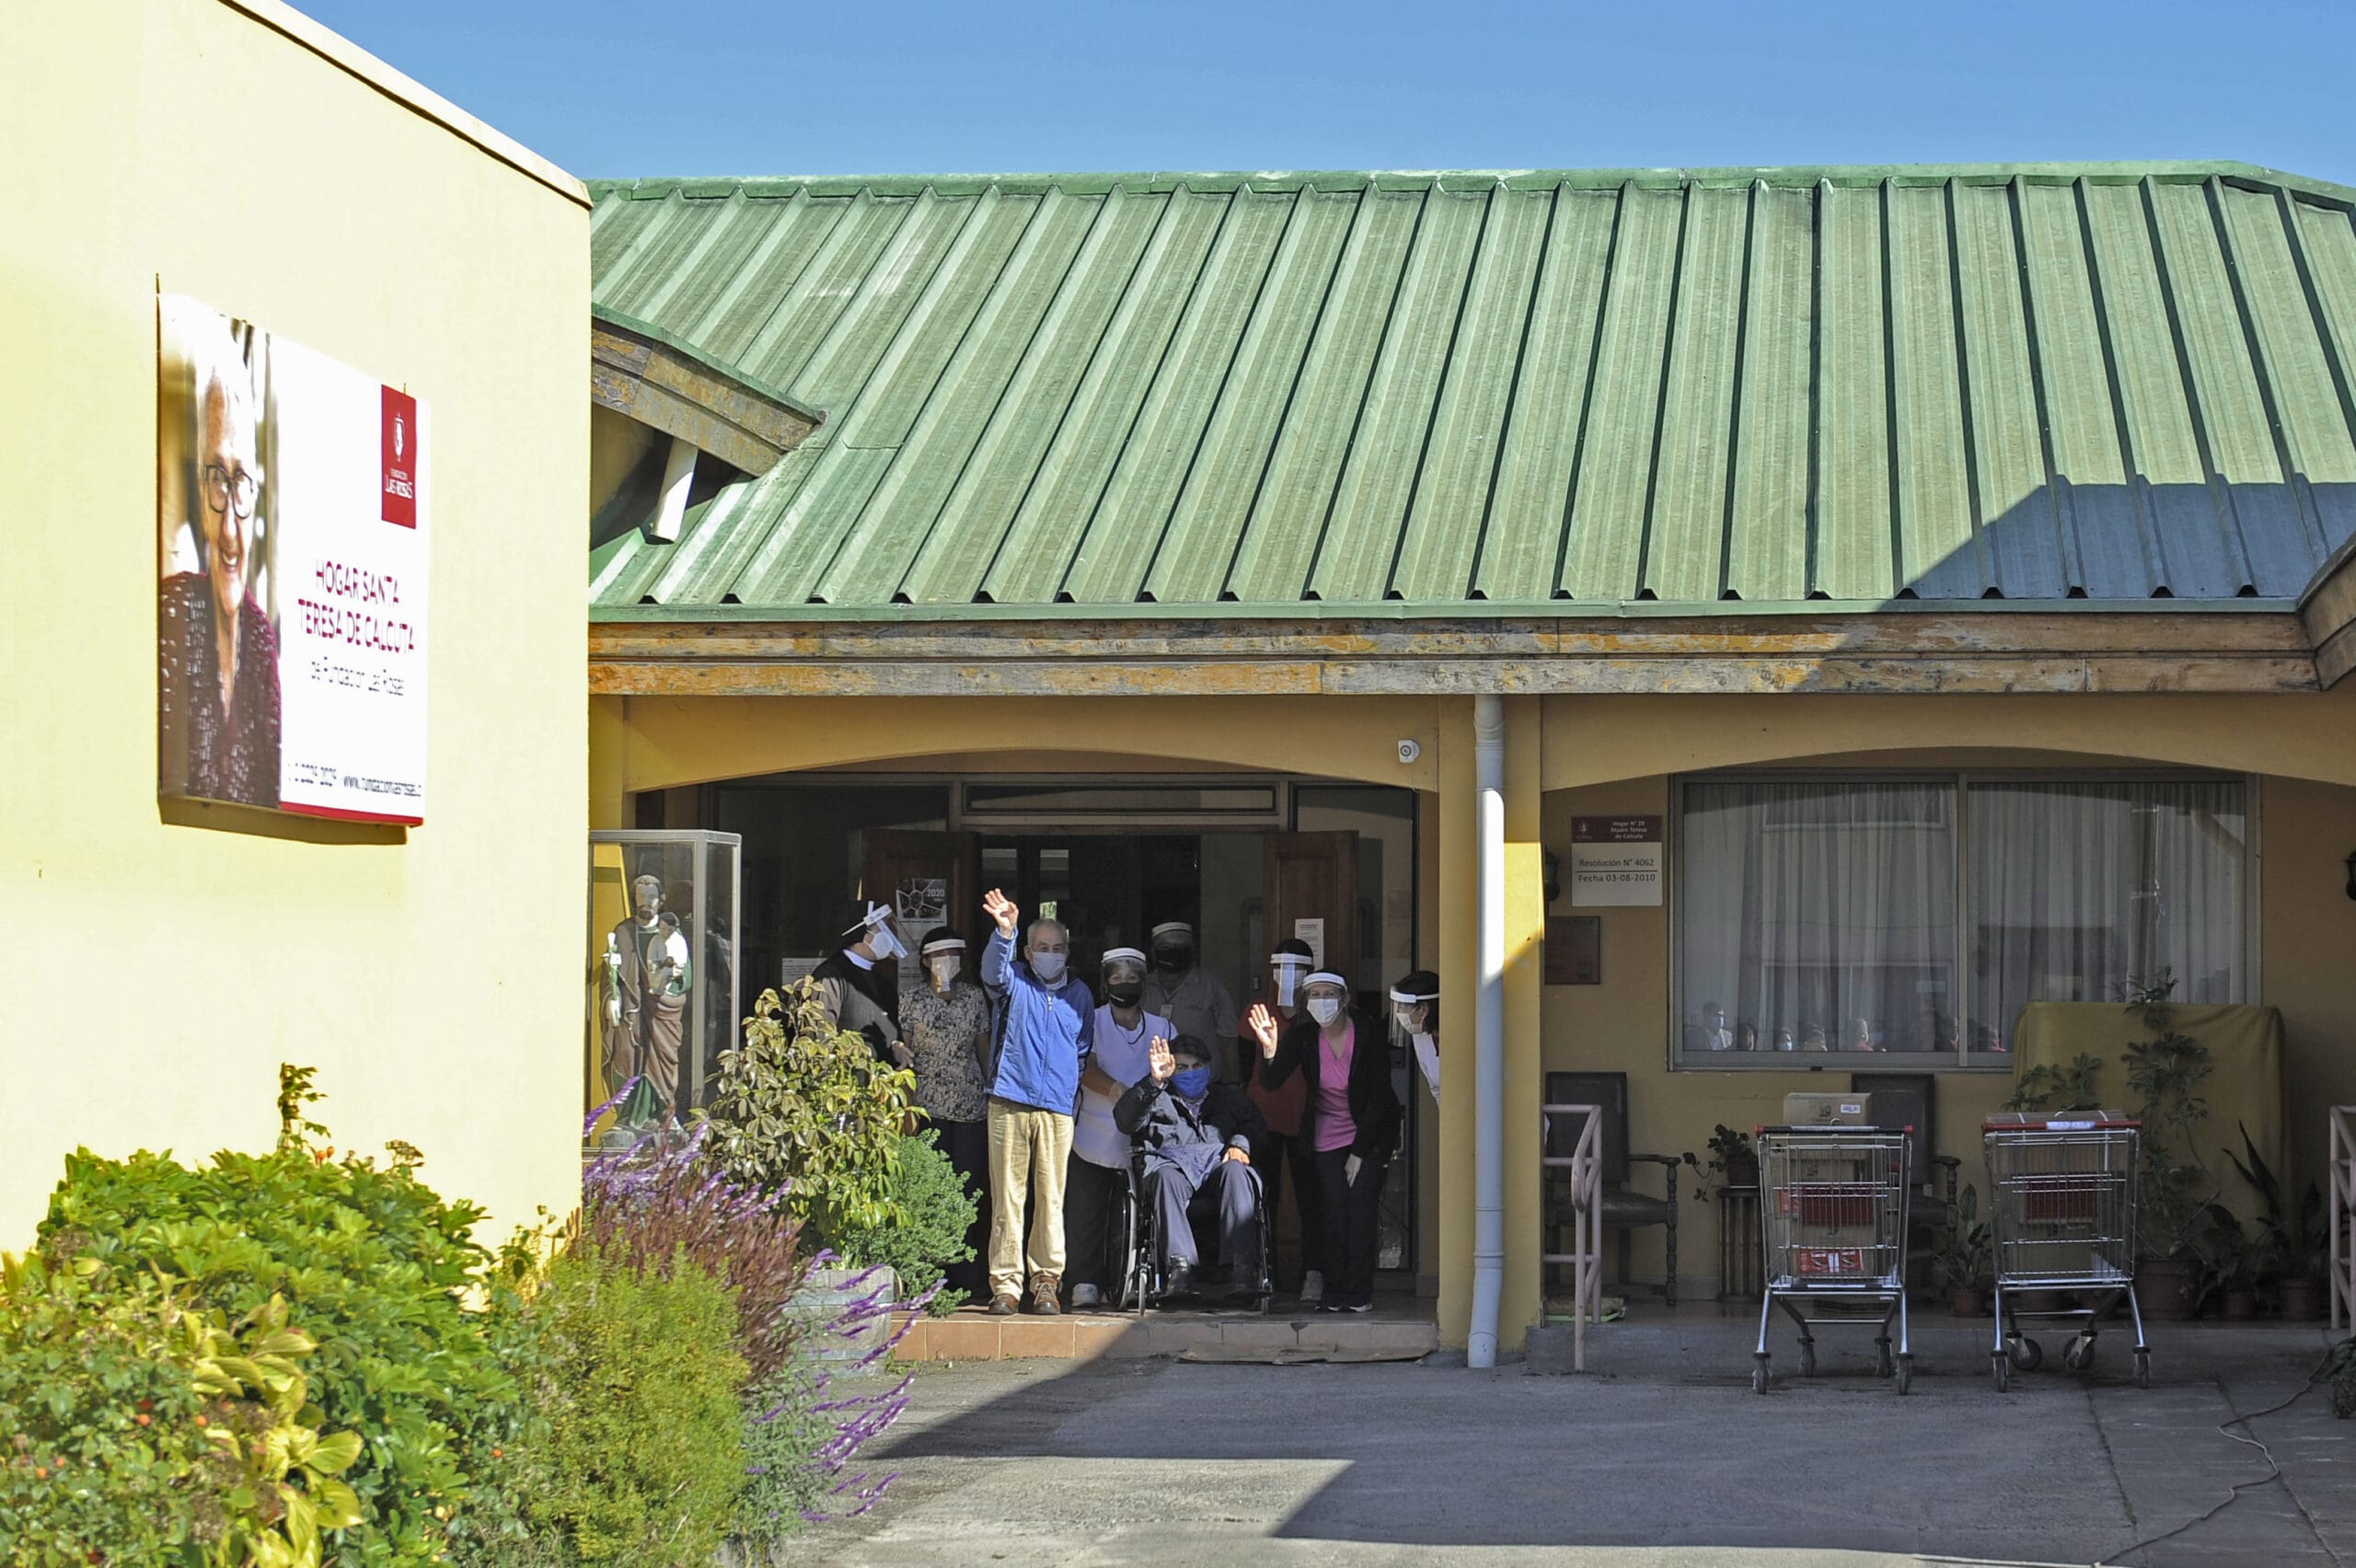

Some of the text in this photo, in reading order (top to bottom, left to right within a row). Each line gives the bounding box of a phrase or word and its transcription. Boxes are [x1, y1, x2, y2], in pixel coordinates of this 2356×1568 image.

[316, 558, 399, 608] HOGAR SANTA
[298, 598, 414, 654] TERESA DE CALCUTA
[1578, 859, 1622, 867] Resolución
[1634, 858, 1655, 866] 4062
[1578, 873, 1656, 882] Fecha 03-08-2010
[927, 888, 945, 897] 2020
